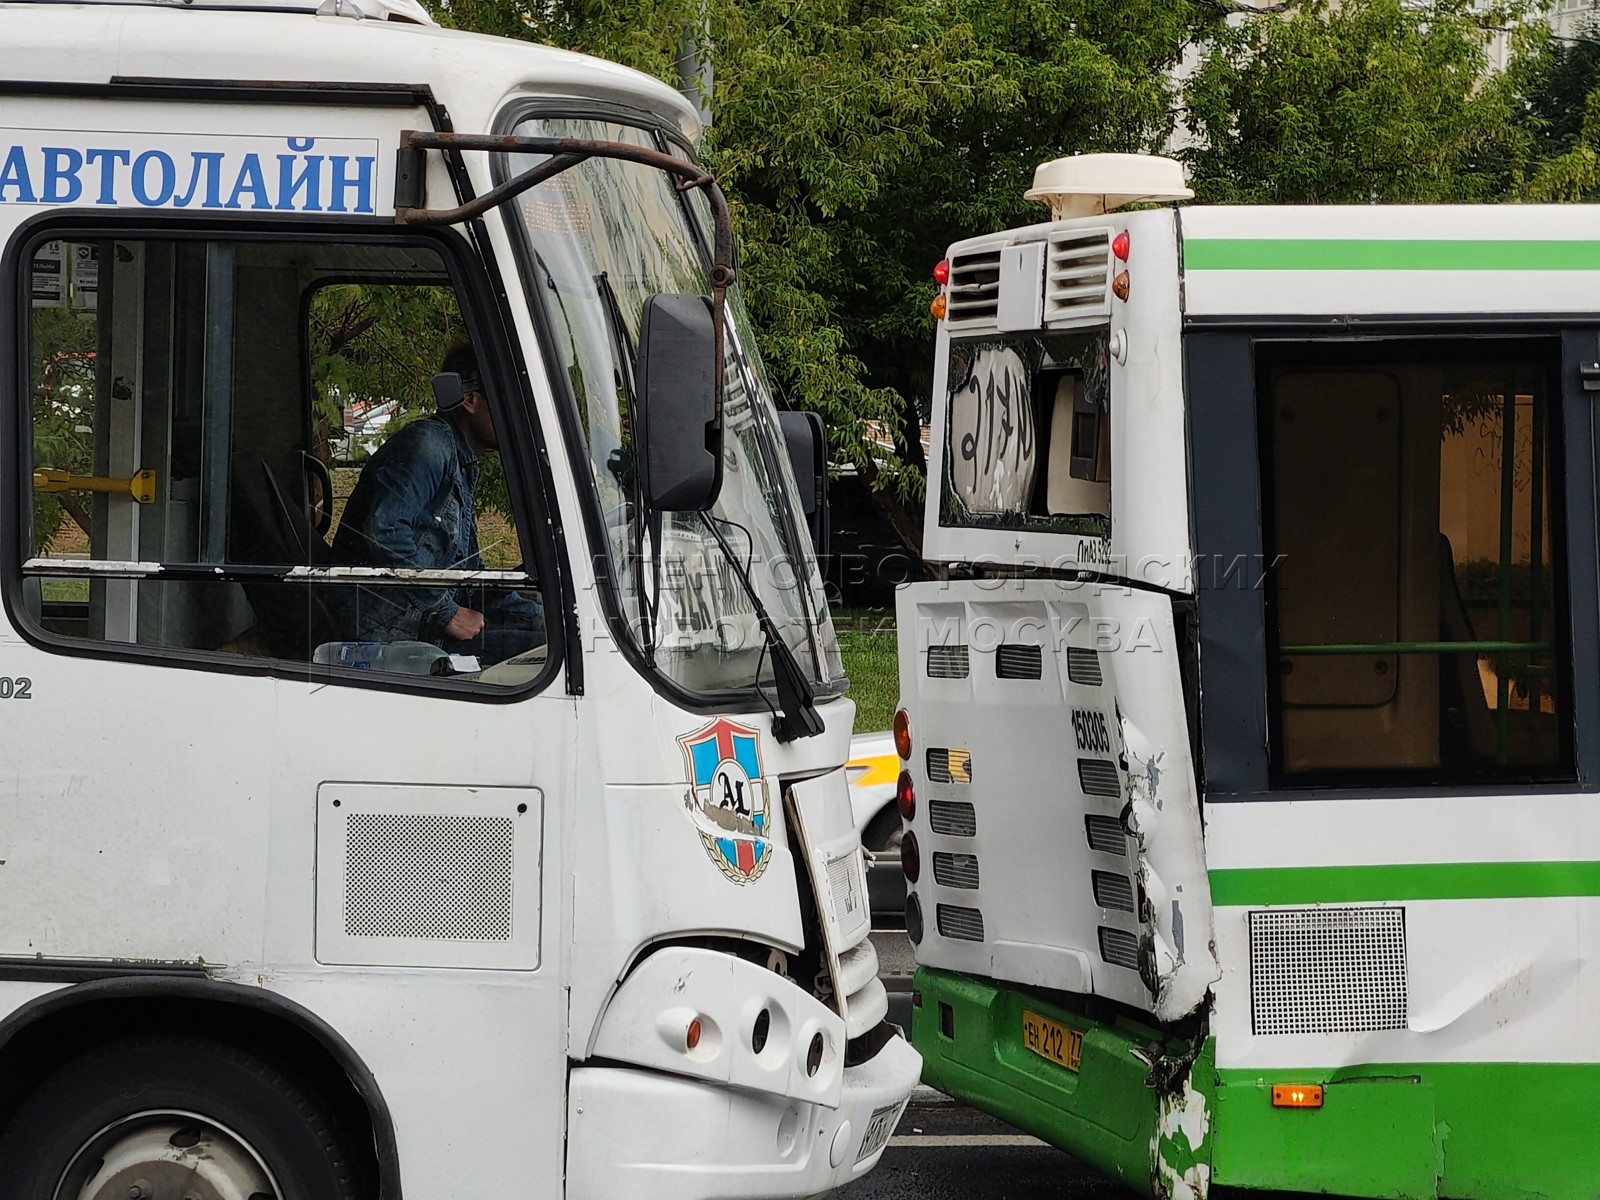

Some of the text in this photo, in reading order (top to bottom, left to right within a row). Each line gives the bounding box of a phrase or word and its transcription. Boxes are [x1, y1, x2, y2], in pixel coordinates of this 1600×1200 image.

[0, 137, 375, 213] АВТОЛАЙН
[0, 677, 32, 699] 02
[1071, 709, 1110, 753] 150305
[1042, 1022, 1063, 1060] 212
